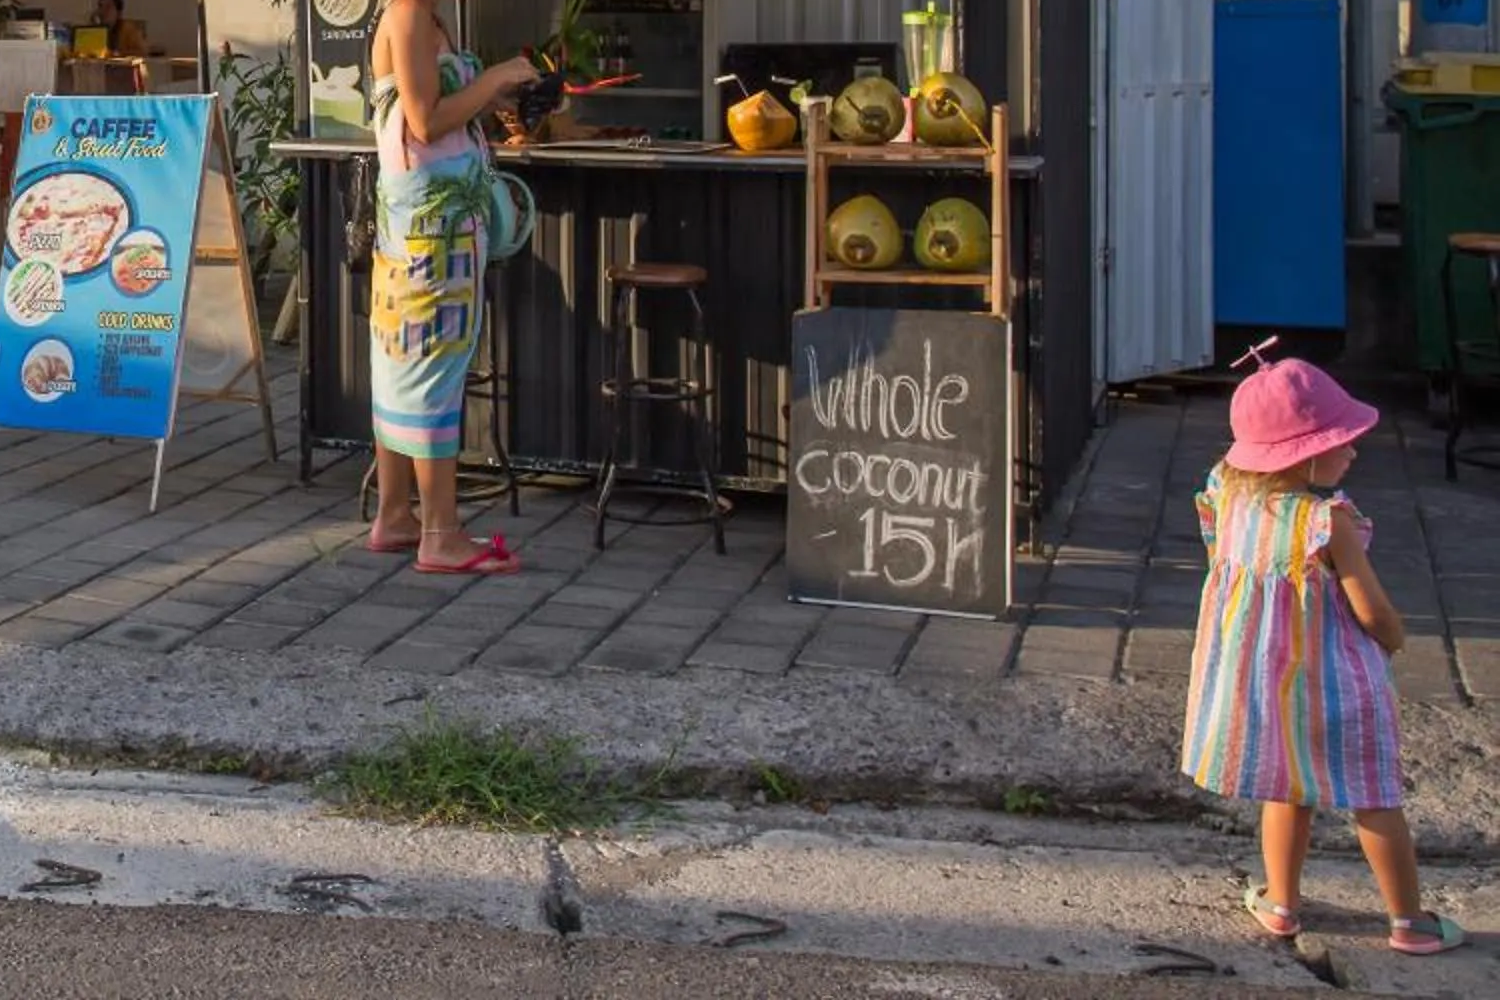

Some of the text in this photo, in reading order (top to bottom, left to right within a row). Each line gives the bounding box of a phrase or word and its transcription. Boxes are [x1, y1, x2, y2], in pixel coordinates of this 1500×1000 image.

[71, 118, 157, 139] CAFFEE
[122, 136, 168, 160] Food
[131, 313, 175, 330] DRINKS
[804, 338, 969, 441] Whole
